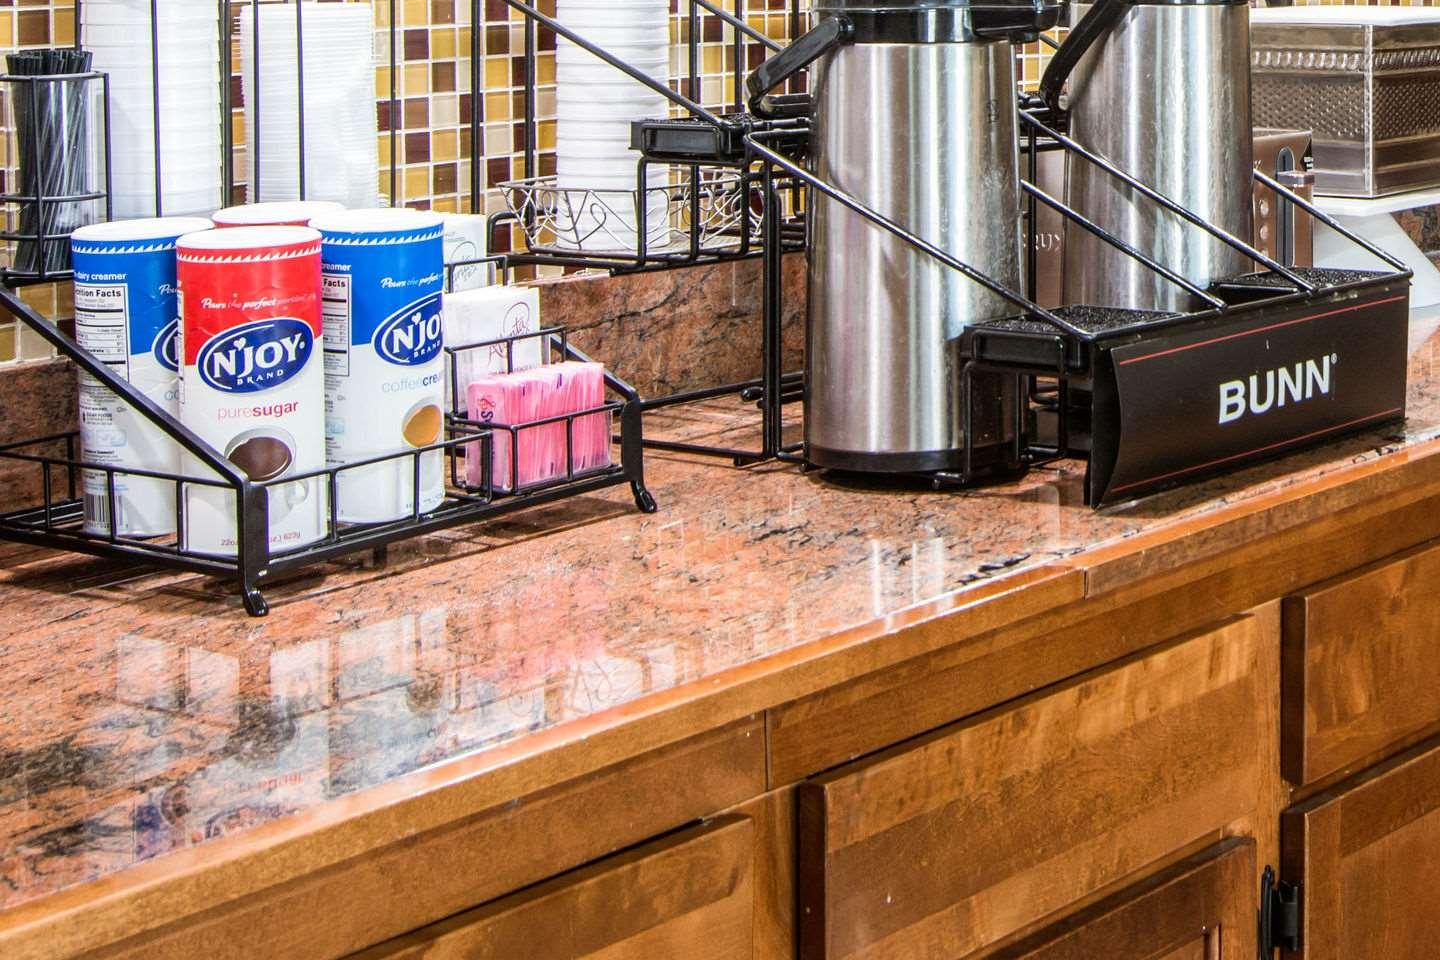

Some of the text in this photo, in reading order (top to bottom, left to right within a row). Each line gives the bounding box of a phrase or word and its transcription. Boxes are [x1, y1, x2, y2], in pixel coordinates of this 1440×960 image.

[91, 272, 127, 281] creamer
[323, 278, 346, 287] Facts
[96, 289, 121, 297] Facts
[201, 297, 226, 310] Pours
[242, 296, 278, 310] perfect
[393, 311, 442, 354] N'JO
[236, 369, 284, 385] BRAND
